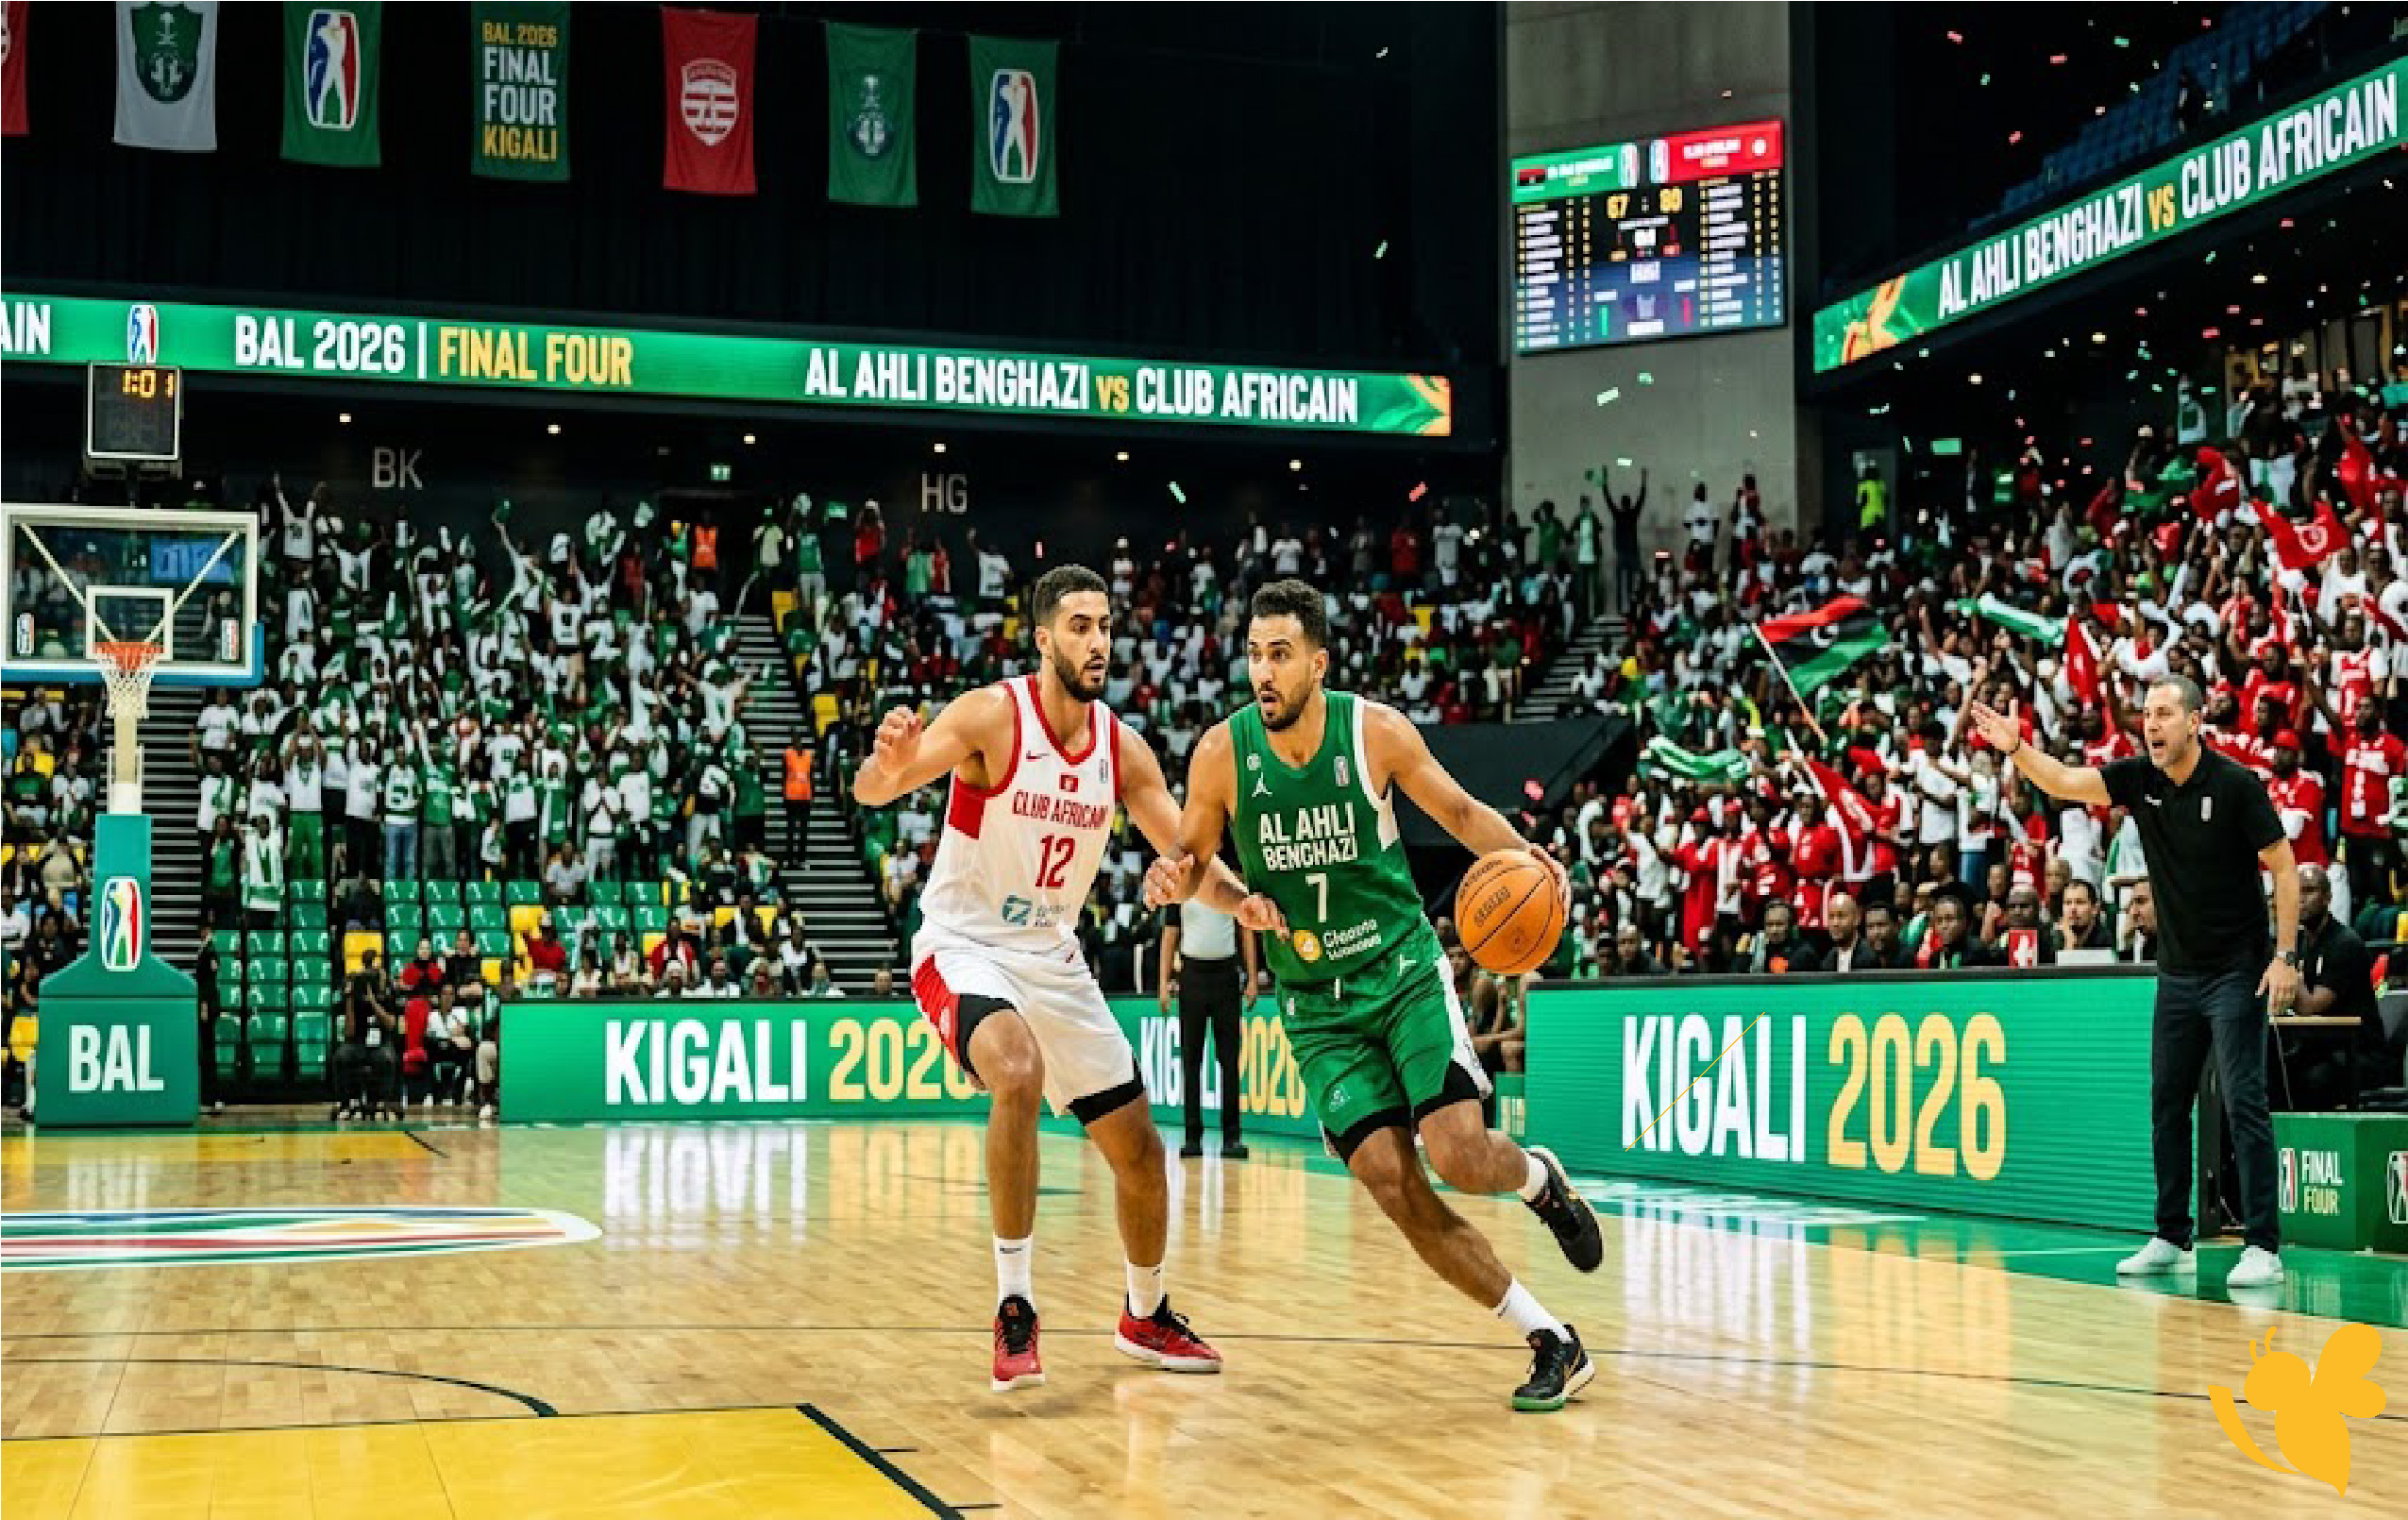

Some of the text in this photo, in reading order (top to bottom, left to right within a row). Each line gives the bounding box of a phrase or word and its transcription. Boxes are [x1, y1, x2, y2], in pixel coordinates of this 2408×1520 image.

[483, 46, 557, 86] FINAL
[483, 83, 557, 127] FOUR
[482, 125, 557, 161] KIGALI
[1938, 72, 2398, 320] AL AHLI BENGHAZI VS CLUB AFRICAIN
[235, 313, 633, 386] BAL 2026 FINAL FOUR
[804, 347, 1358, 424] AL AHLI BENGHAZI VS CLUB AFRICAIN
[372, 448, 423, 489] BK
[920, 473, 969, 515] HG
[1011, 789, 1050, 820] CLUB
[1258, 802, 1356, 844] AL AHLI
[1035, 833, 1076, 889] 12
[1261, 834, 1358, 870] BENGHAZI
[1305, 872, 1329, 923] 7
[68, 1024, 164, 1092] BAL
[604, 1018, 807, 1105] KIGALI
[1622, 1011, 2007, 1181] KIGALI 2026
[2301, 1150, 2345, 1186] FINAL
[2303, 1185, 2340, 1216] FOUR
